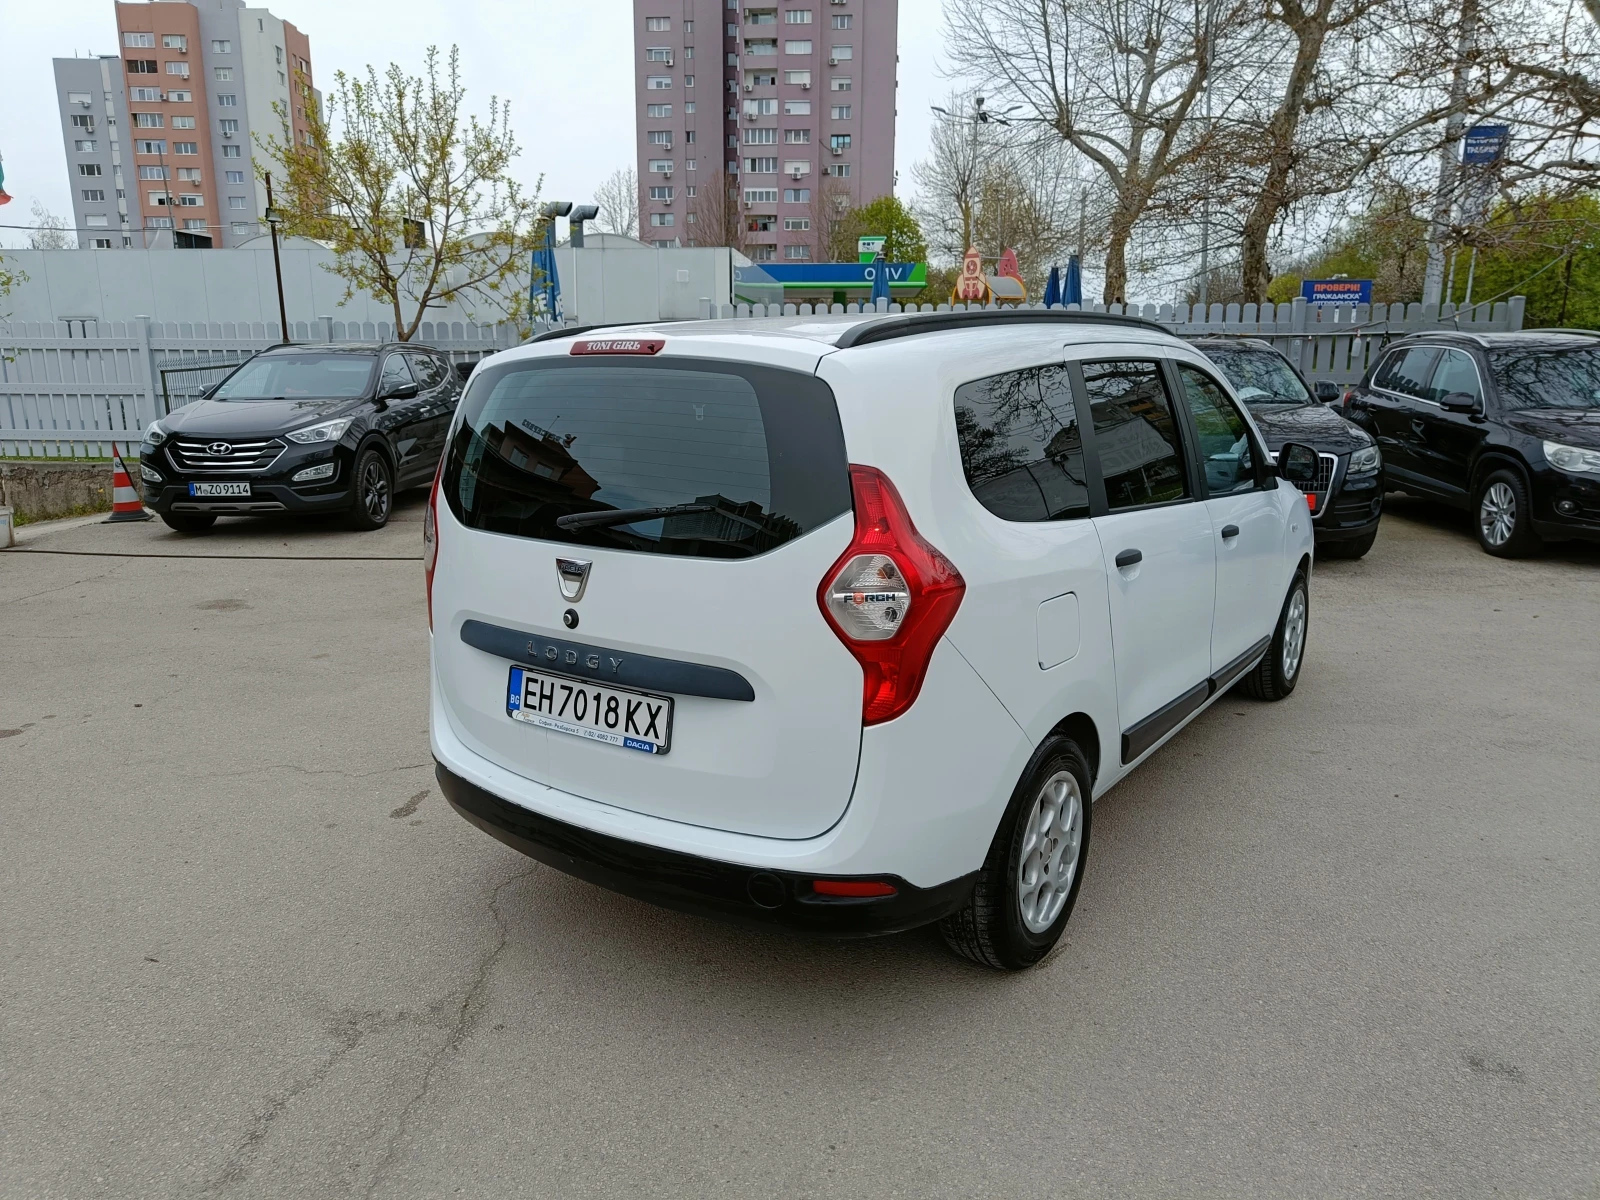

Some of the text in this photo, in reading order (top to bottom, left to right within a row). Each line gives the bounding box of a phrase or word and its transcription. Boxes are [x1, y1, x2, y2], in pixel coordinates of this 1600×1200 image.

[864, 267, 903, 280] OV
[1314, 283, 1361, 292] ПРОВЕРИ!
[586, 341, 641, 351] TONI GIRL
[527, 640, 623, 673] LODGY
[510, 693, 520, 705] BG
[626, 740, 650, 751] DACIA
